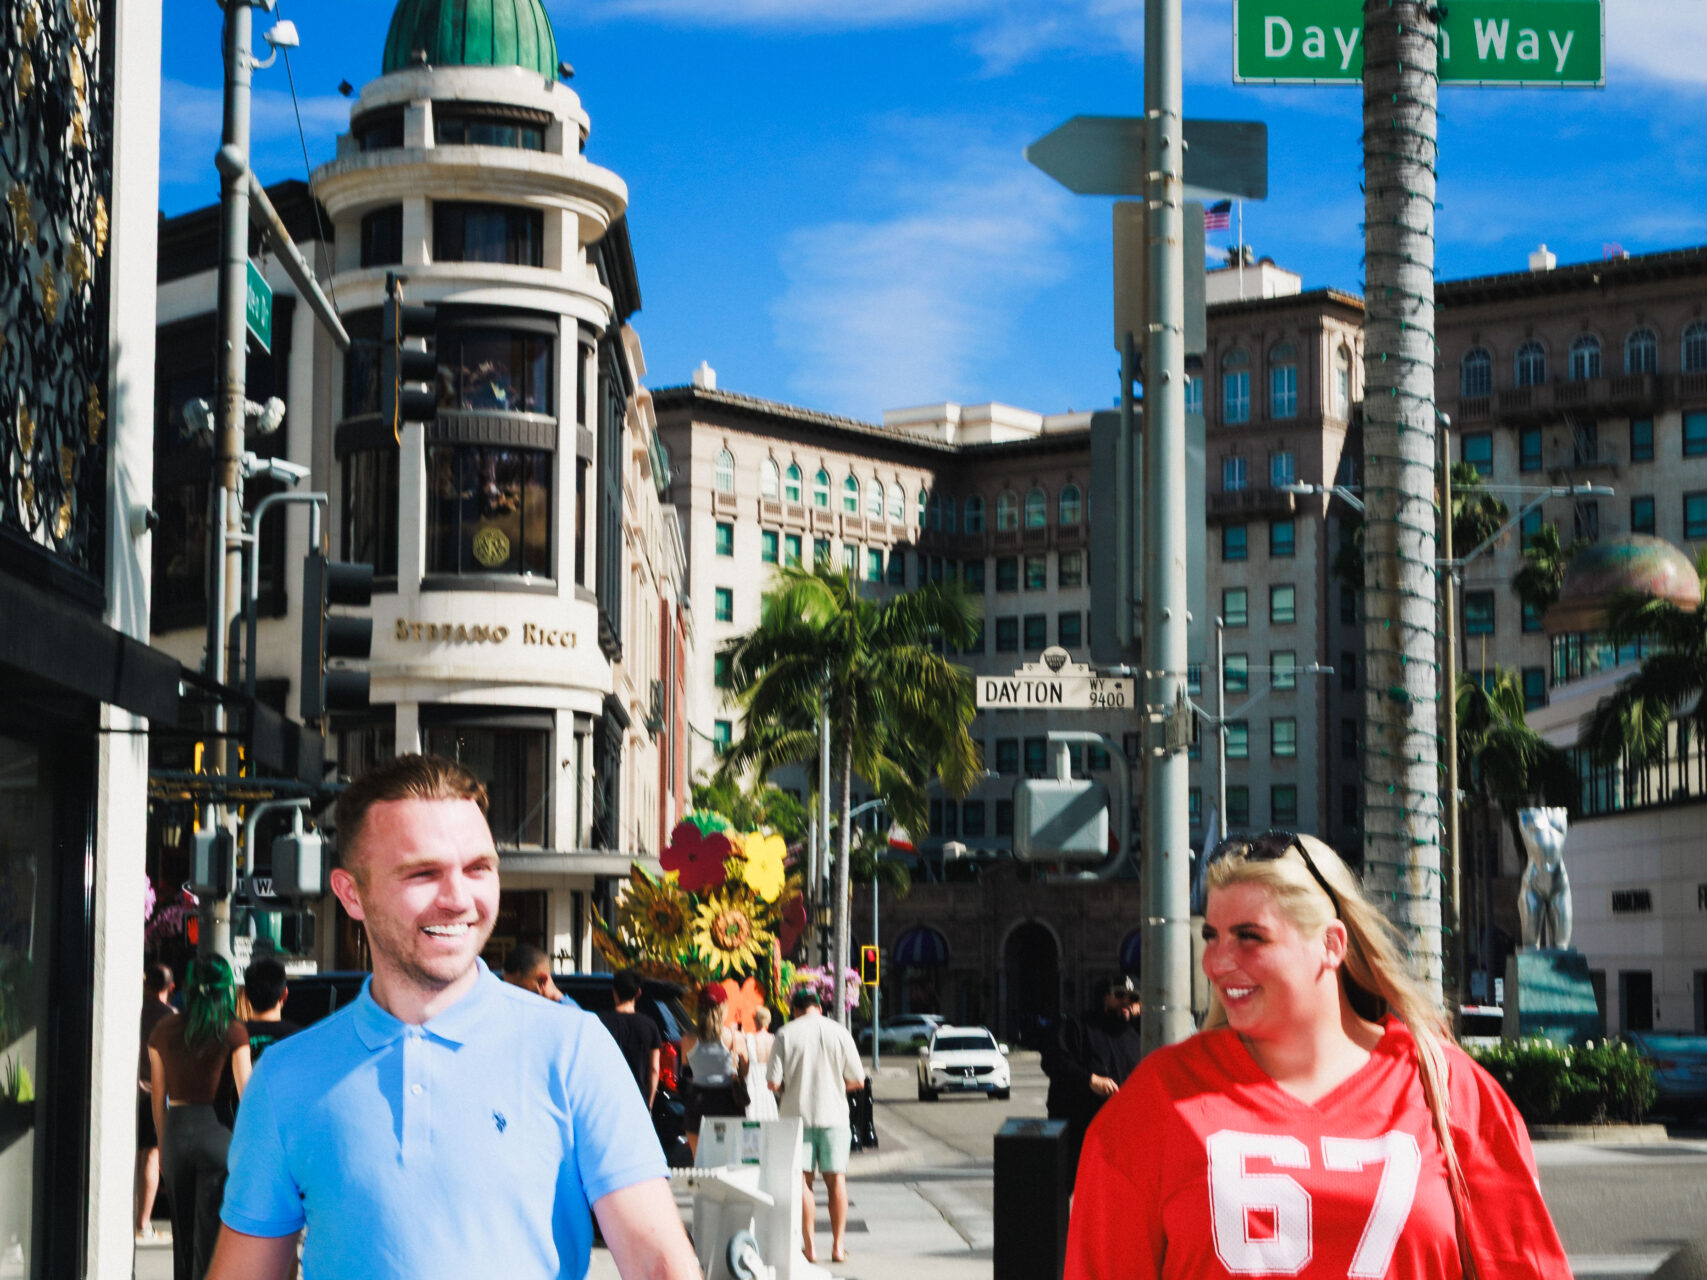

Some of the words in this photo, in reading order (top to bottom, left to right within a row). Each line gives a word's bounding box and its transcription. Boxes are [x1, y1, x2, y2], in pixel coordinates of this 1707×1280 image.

[1473, 18, 1575, 73] Way
[523, 622, 577, 648] RICCI
[985, 680, 1063, 704] DAYTON
[1089, 678, 1106, 691] WY
[1089, 691, 1125, 708] 9400
